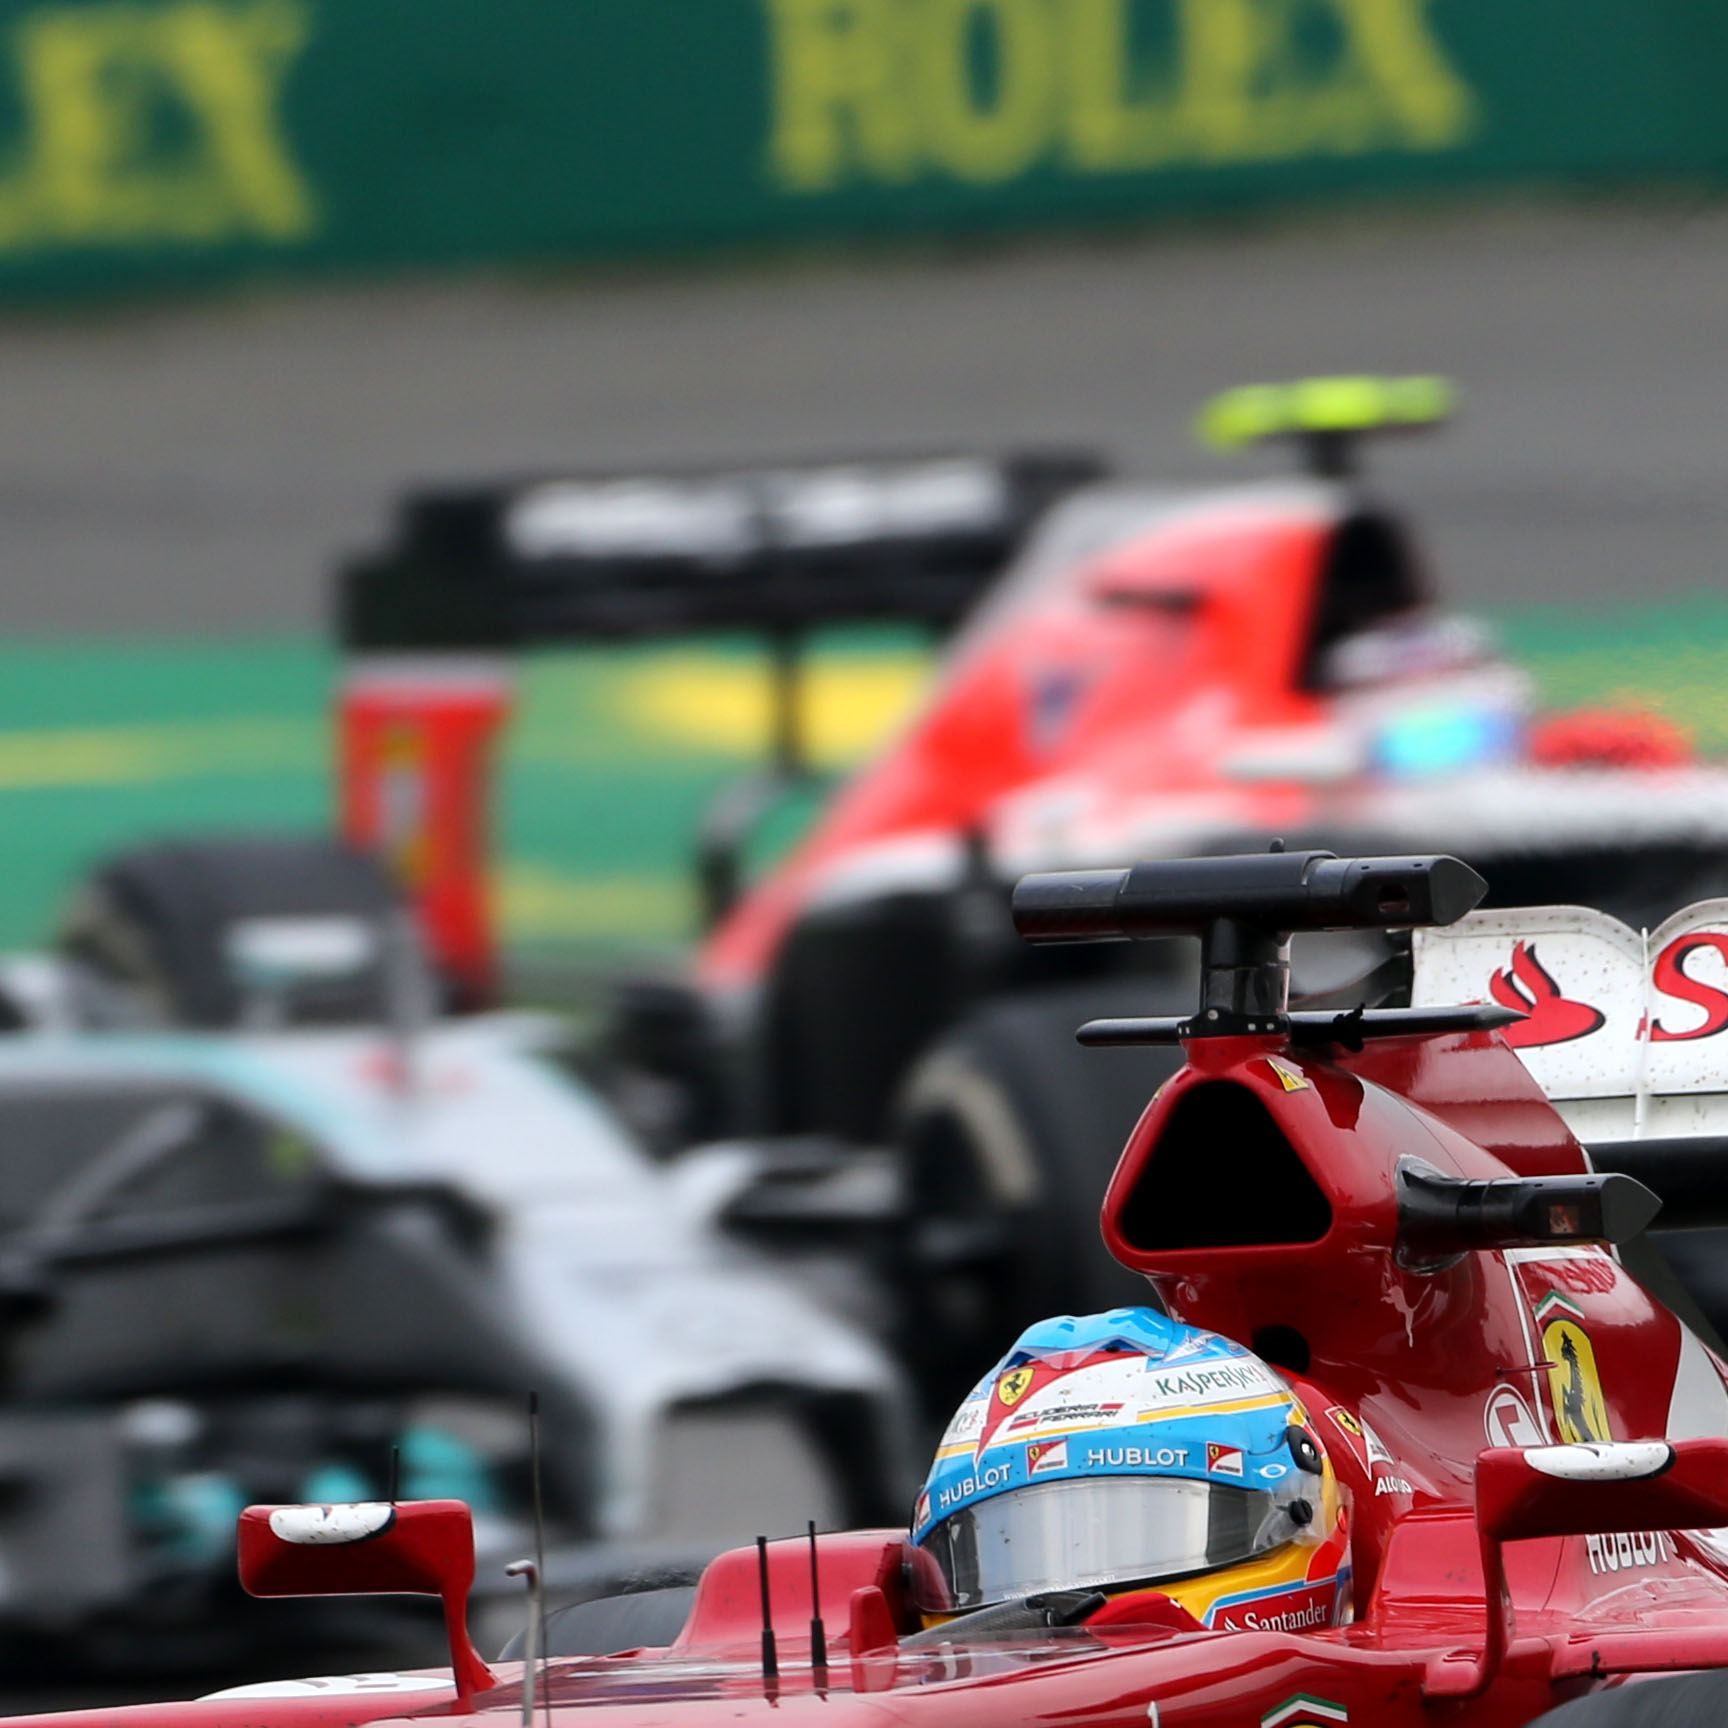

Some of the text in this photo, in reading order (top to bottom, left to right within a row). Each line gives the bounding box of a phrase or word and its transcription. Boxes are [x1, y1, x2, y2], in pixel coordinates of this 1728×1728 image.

[1155, 1364, 1261, 1396] KASPERSKY
[1087, 1447, 1189, 1467] HUBLOT
[938, 1463, 1011, 1509] HUBLOT
